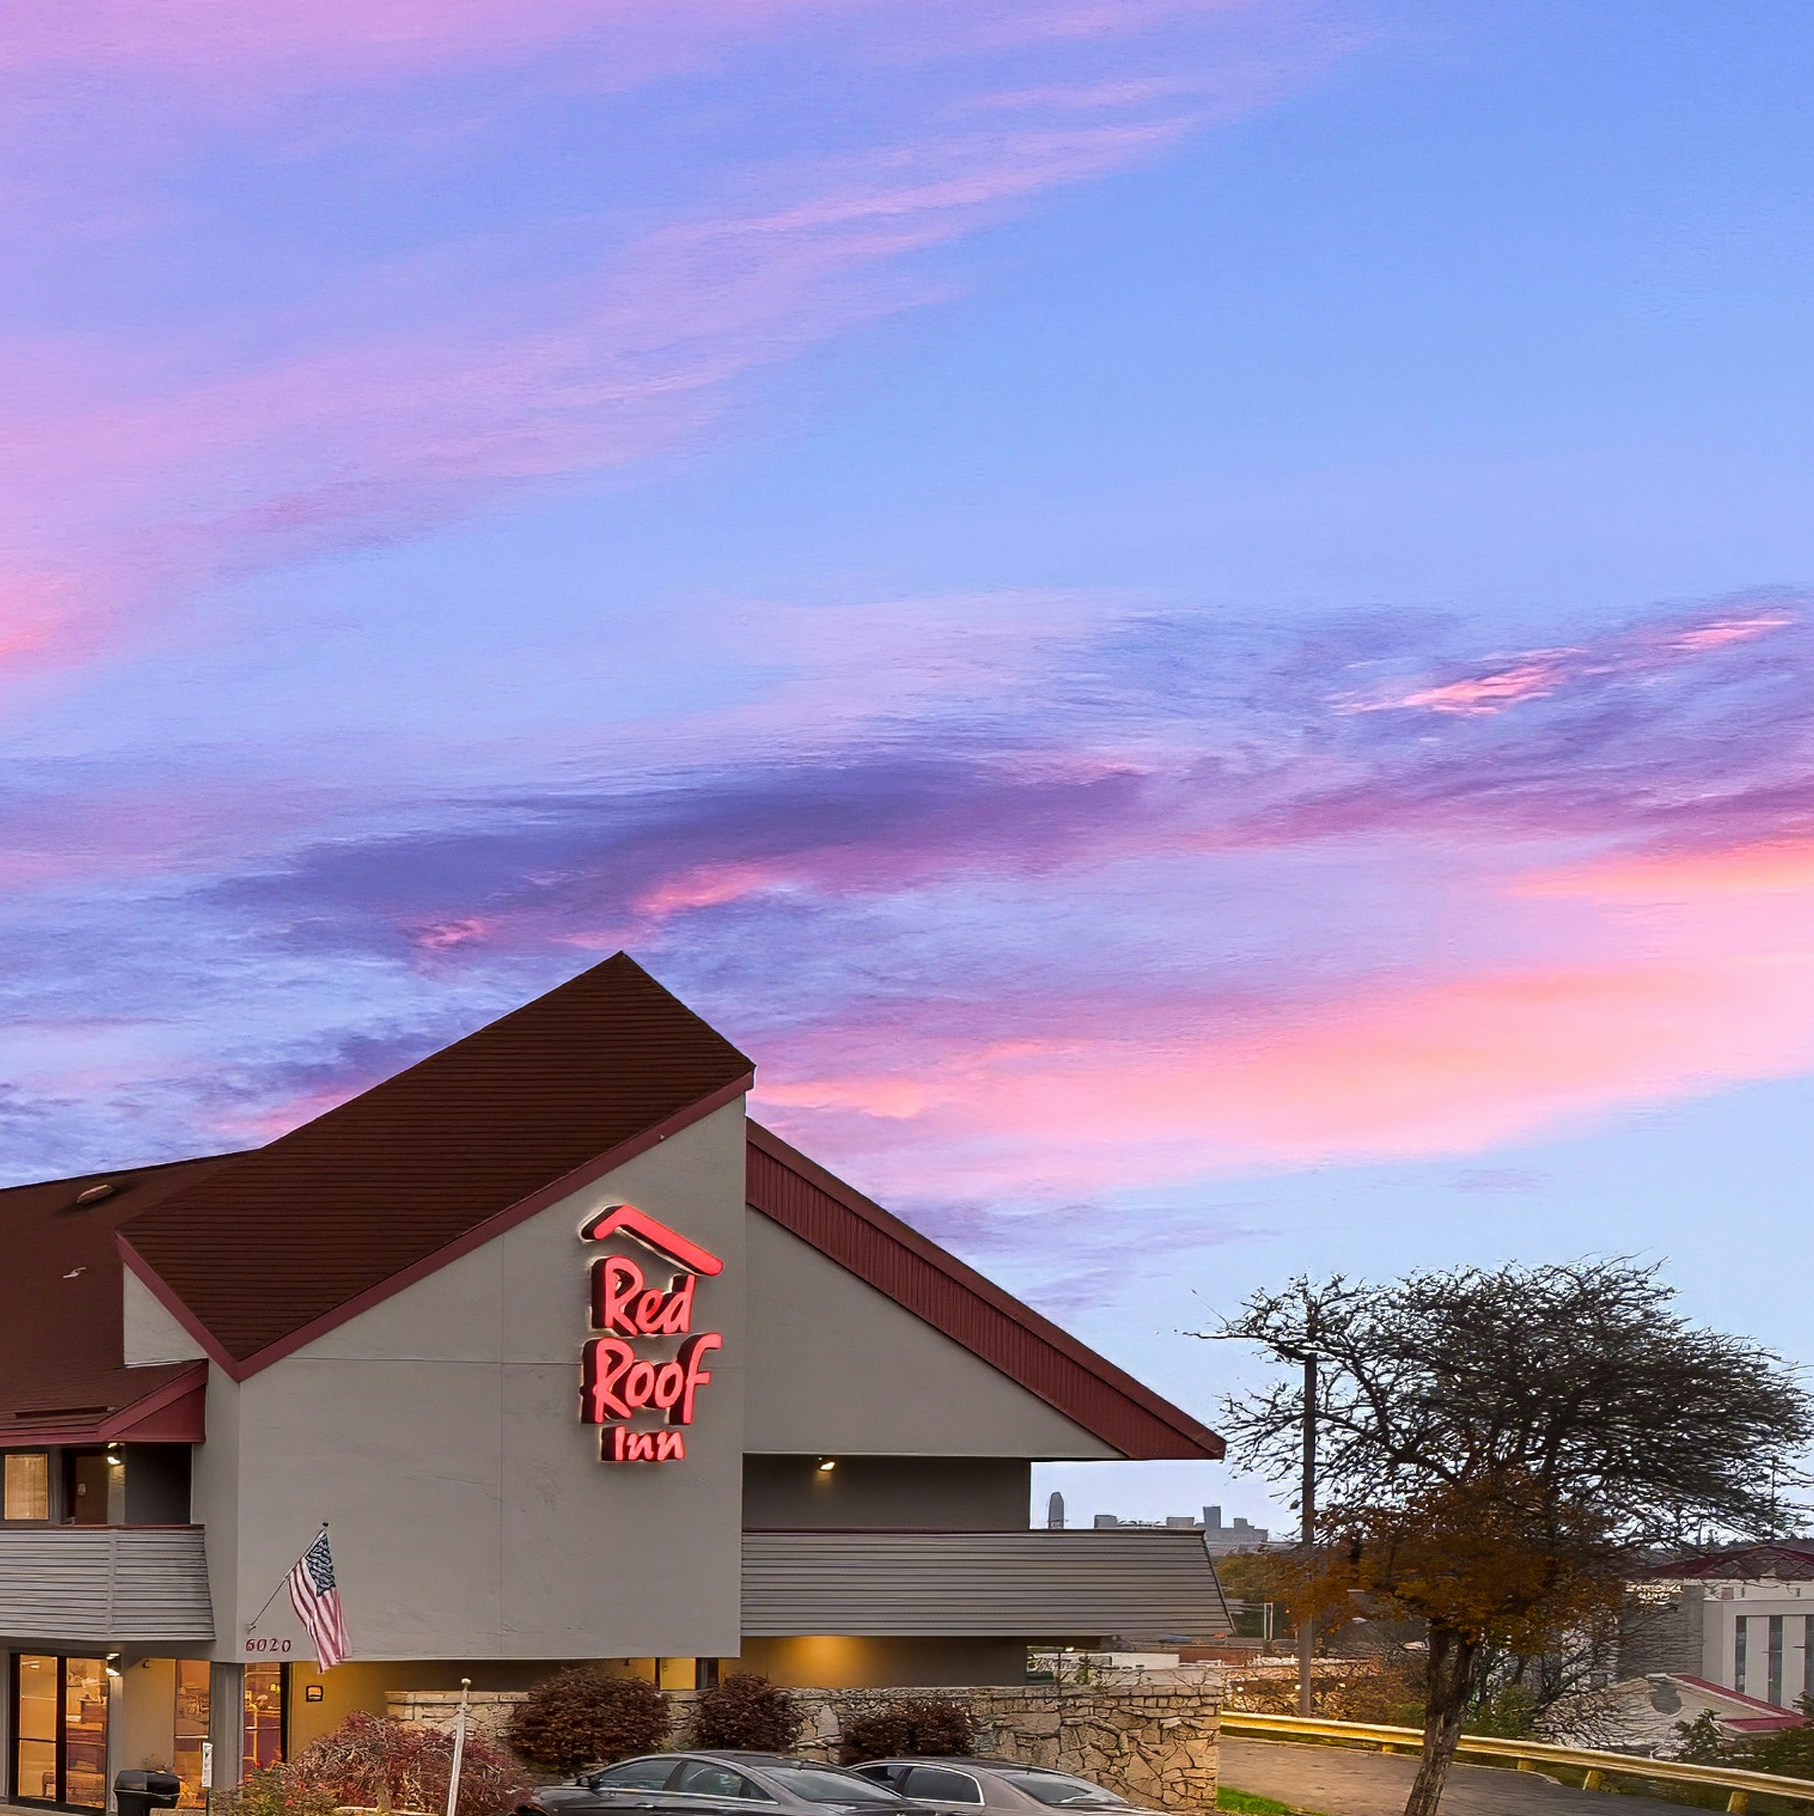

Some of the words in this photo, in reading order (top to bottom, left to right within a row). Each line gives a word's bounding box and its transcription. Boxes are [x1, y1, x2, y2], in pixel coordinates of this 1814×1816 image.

[601, 1256, 695, 1336] Red
[590, 1333, 723, 1424] Roof
[612, 1425, 685, 1461] Inn
[245, 1638, 291, 1652] 6020
